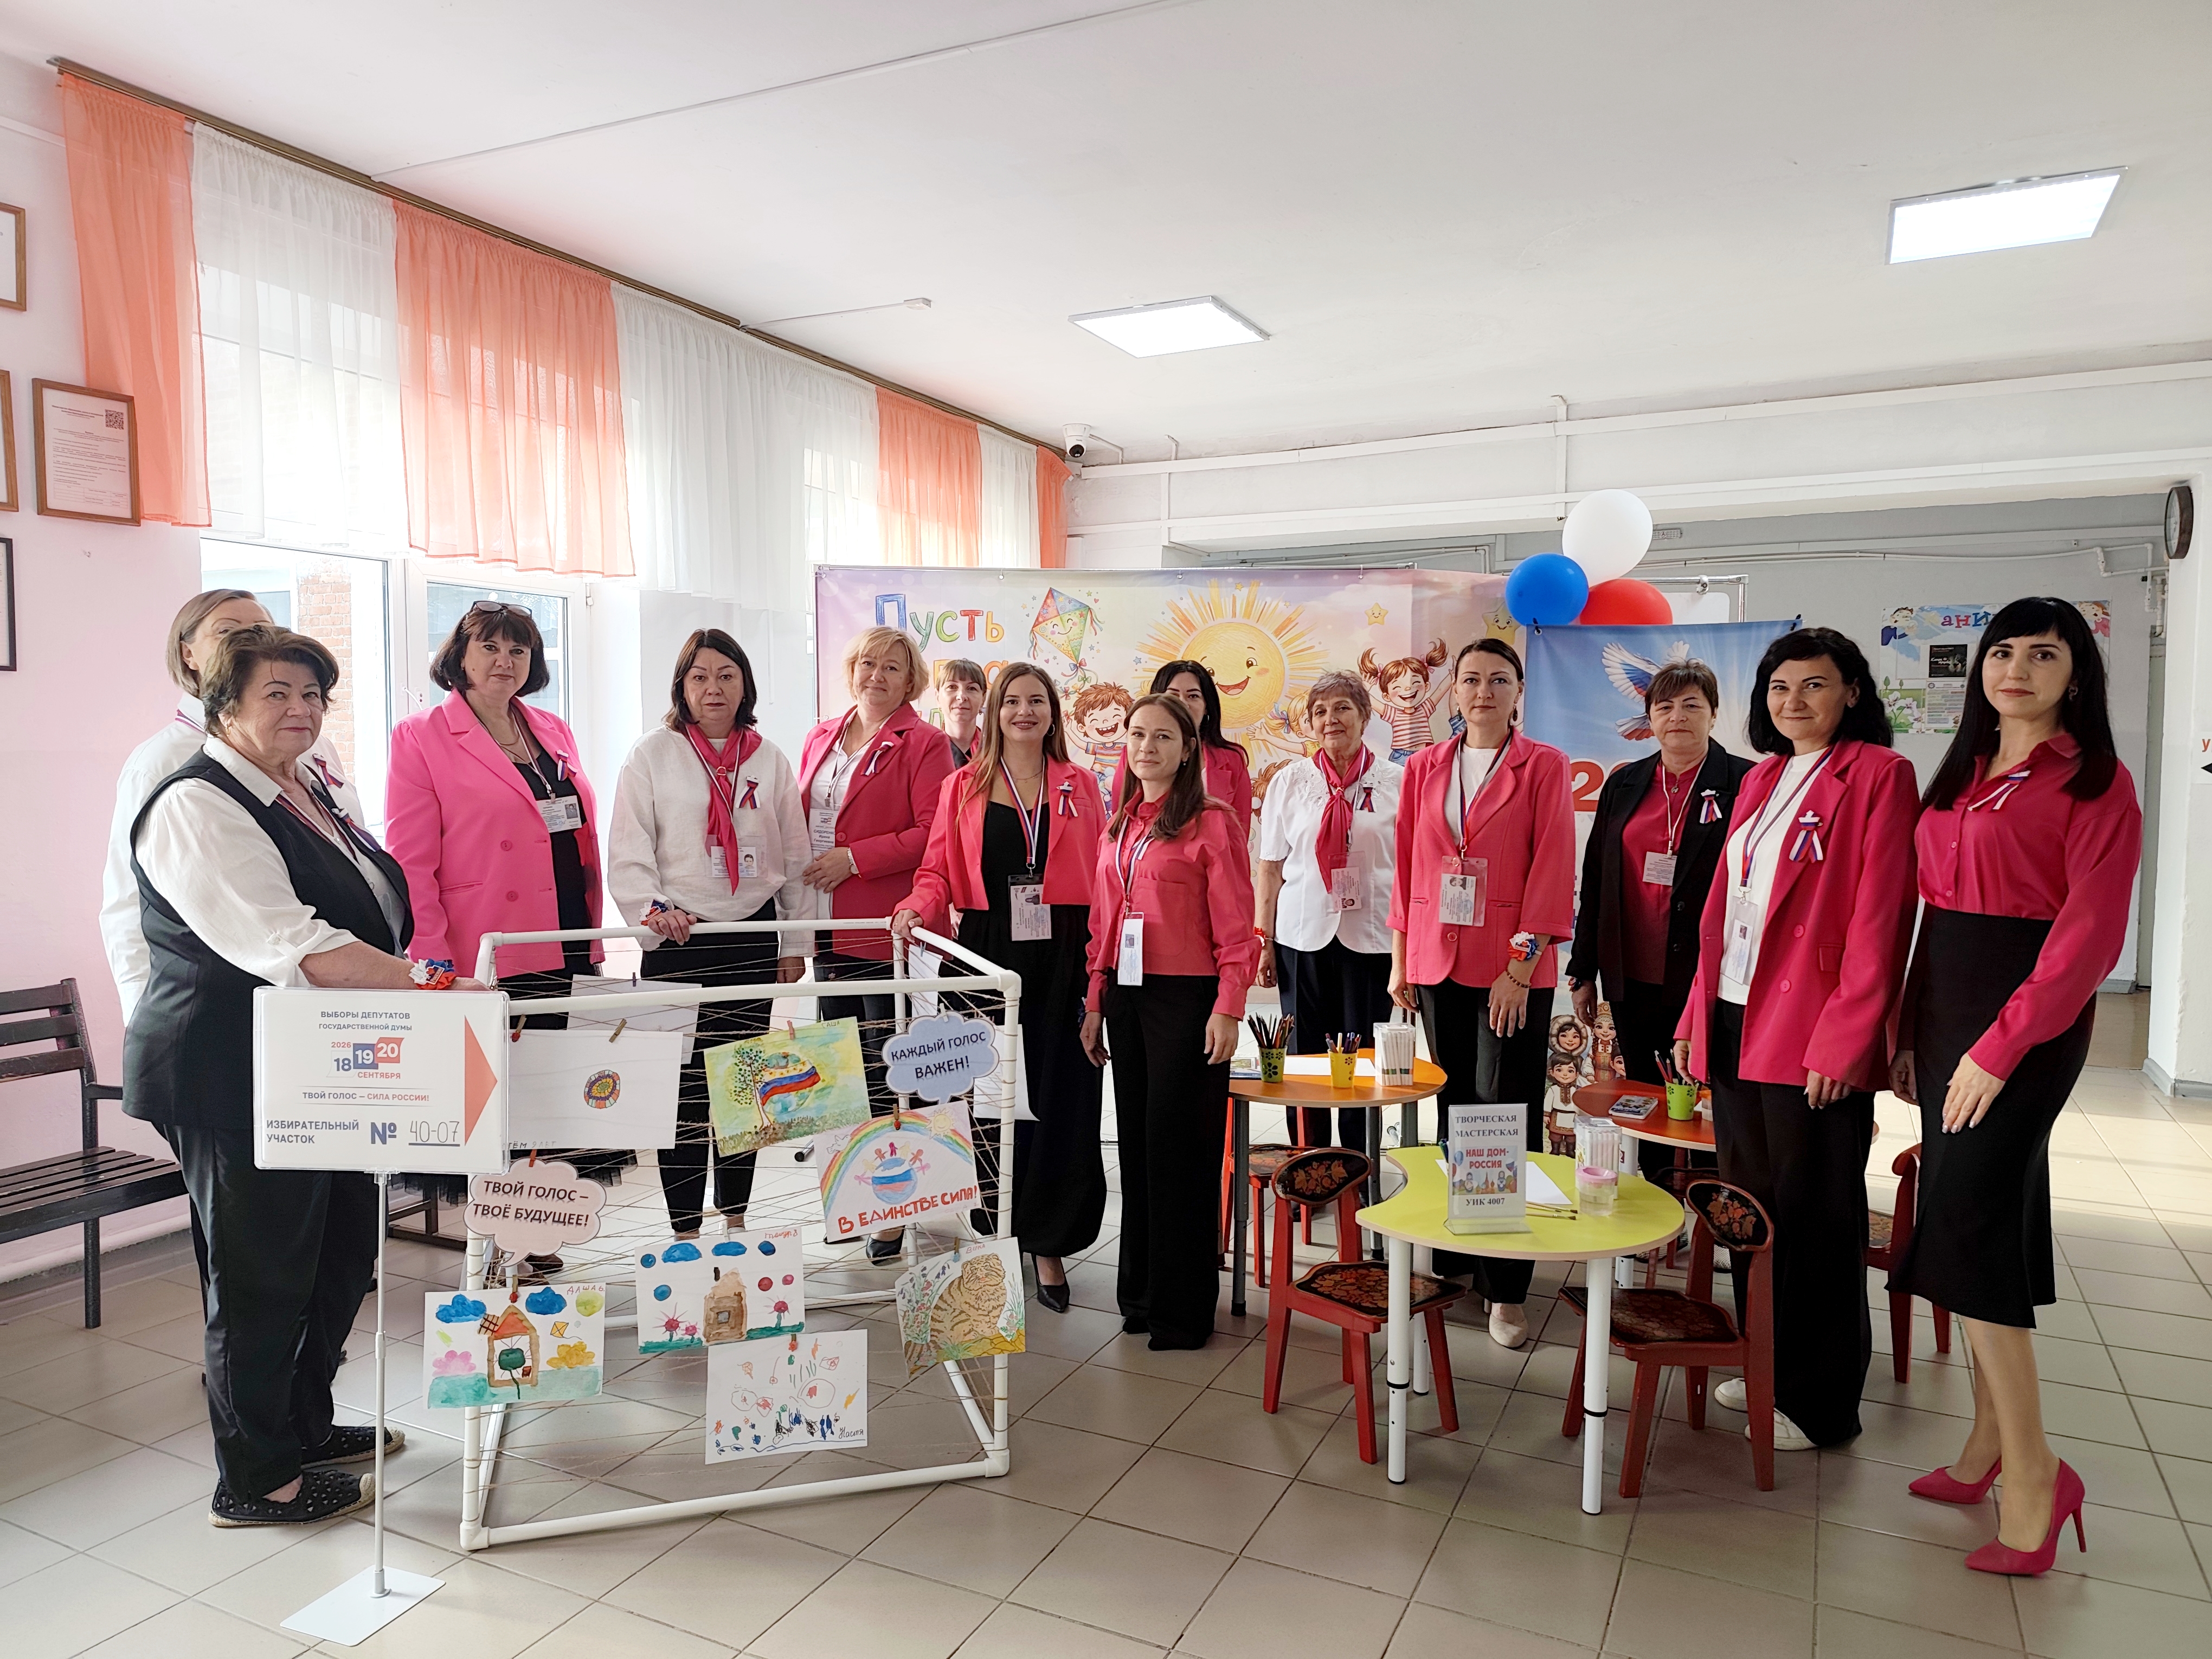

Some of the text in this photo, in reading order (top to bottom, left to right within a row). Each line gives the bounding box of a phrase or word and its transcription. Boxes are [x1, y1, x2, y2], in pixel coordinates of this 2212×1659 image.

[875, 593, 1005, 653] Пусть
[361, 1011, 410, 1020] ДЕПУТАТОВ
[319, 1023, 390, 1031] ГОСУДАРСТВЕННОЙ
[891, 1031, 986, 1061] КАЖДЫЙ ГОЛОС
[333, 1043, 398, 1072] 18 19 20
[915, 1056, 969, 1079] ВАЖЕН!
[358, 1071, 401, 1079] СЕНТЯБРЯ
[303, 1091, 326, 1099] ТВОЙ
[1455, 1115, 1517, 1124] ТВОРЧЕСКАЯ
[267, 1120, 359, 1130] ИЗБИРАТЕЛЬНЫЙ
[370, 1121, 460, 1144] № 40-07
[1455, 1129, 1519, 1137] МАСТЕРСКАЯ
[267, 1134, 315, 1144] УЧАСТОК
[508, 1141, 528, 1149] ТЁМ
[1466, 1148, 1509, 1158] НАШ ДОМ-
[1469, 1160, 1502, 1169] РОССИЯ
[484, 1180, 524, 1197] ТВОЙ
[528, 1185, 577, 1201] ГОЛОС
[473, 1203, 589, 1227] ТВОЁ БУДУЩЕЕ!
[838, 1217, 854, 1234] В
[858, 1195, 939, 1227] ЕДИНСТВЕ
[966, 1244, 986, 1254] ВИКА
[567, 1284, 596, 1295] ДАША
[838, 1427, 864, 1439] Настя
